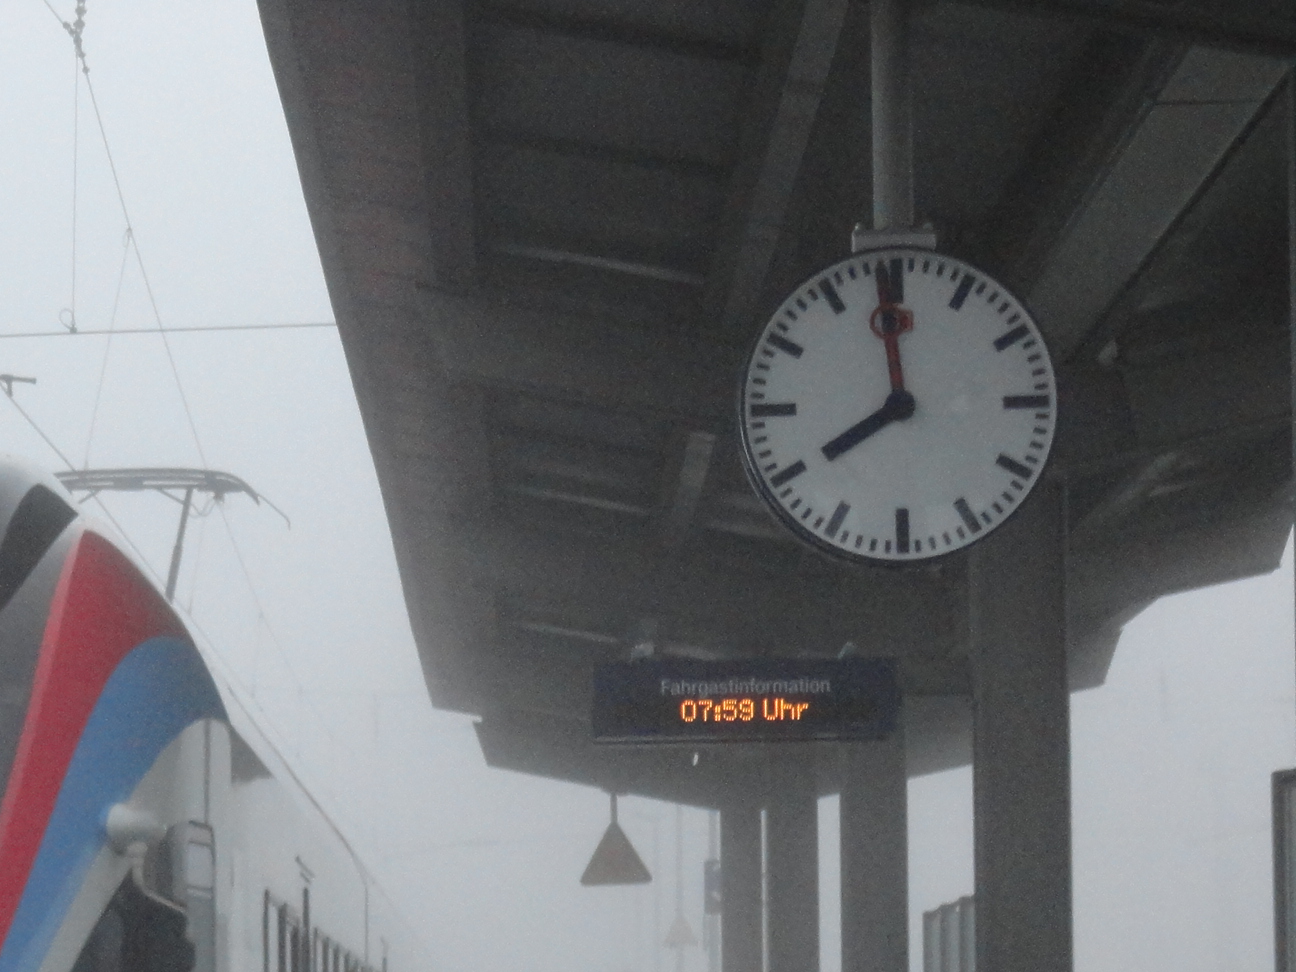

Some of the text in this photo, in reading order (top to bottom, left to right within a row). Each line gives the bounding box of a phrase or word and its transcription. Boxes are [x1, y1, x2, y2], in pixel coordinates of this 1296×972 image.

[659, 678, 831, 697] Fahrgastinformation
[680, 697, 809, 722] 07:59 Uhr
